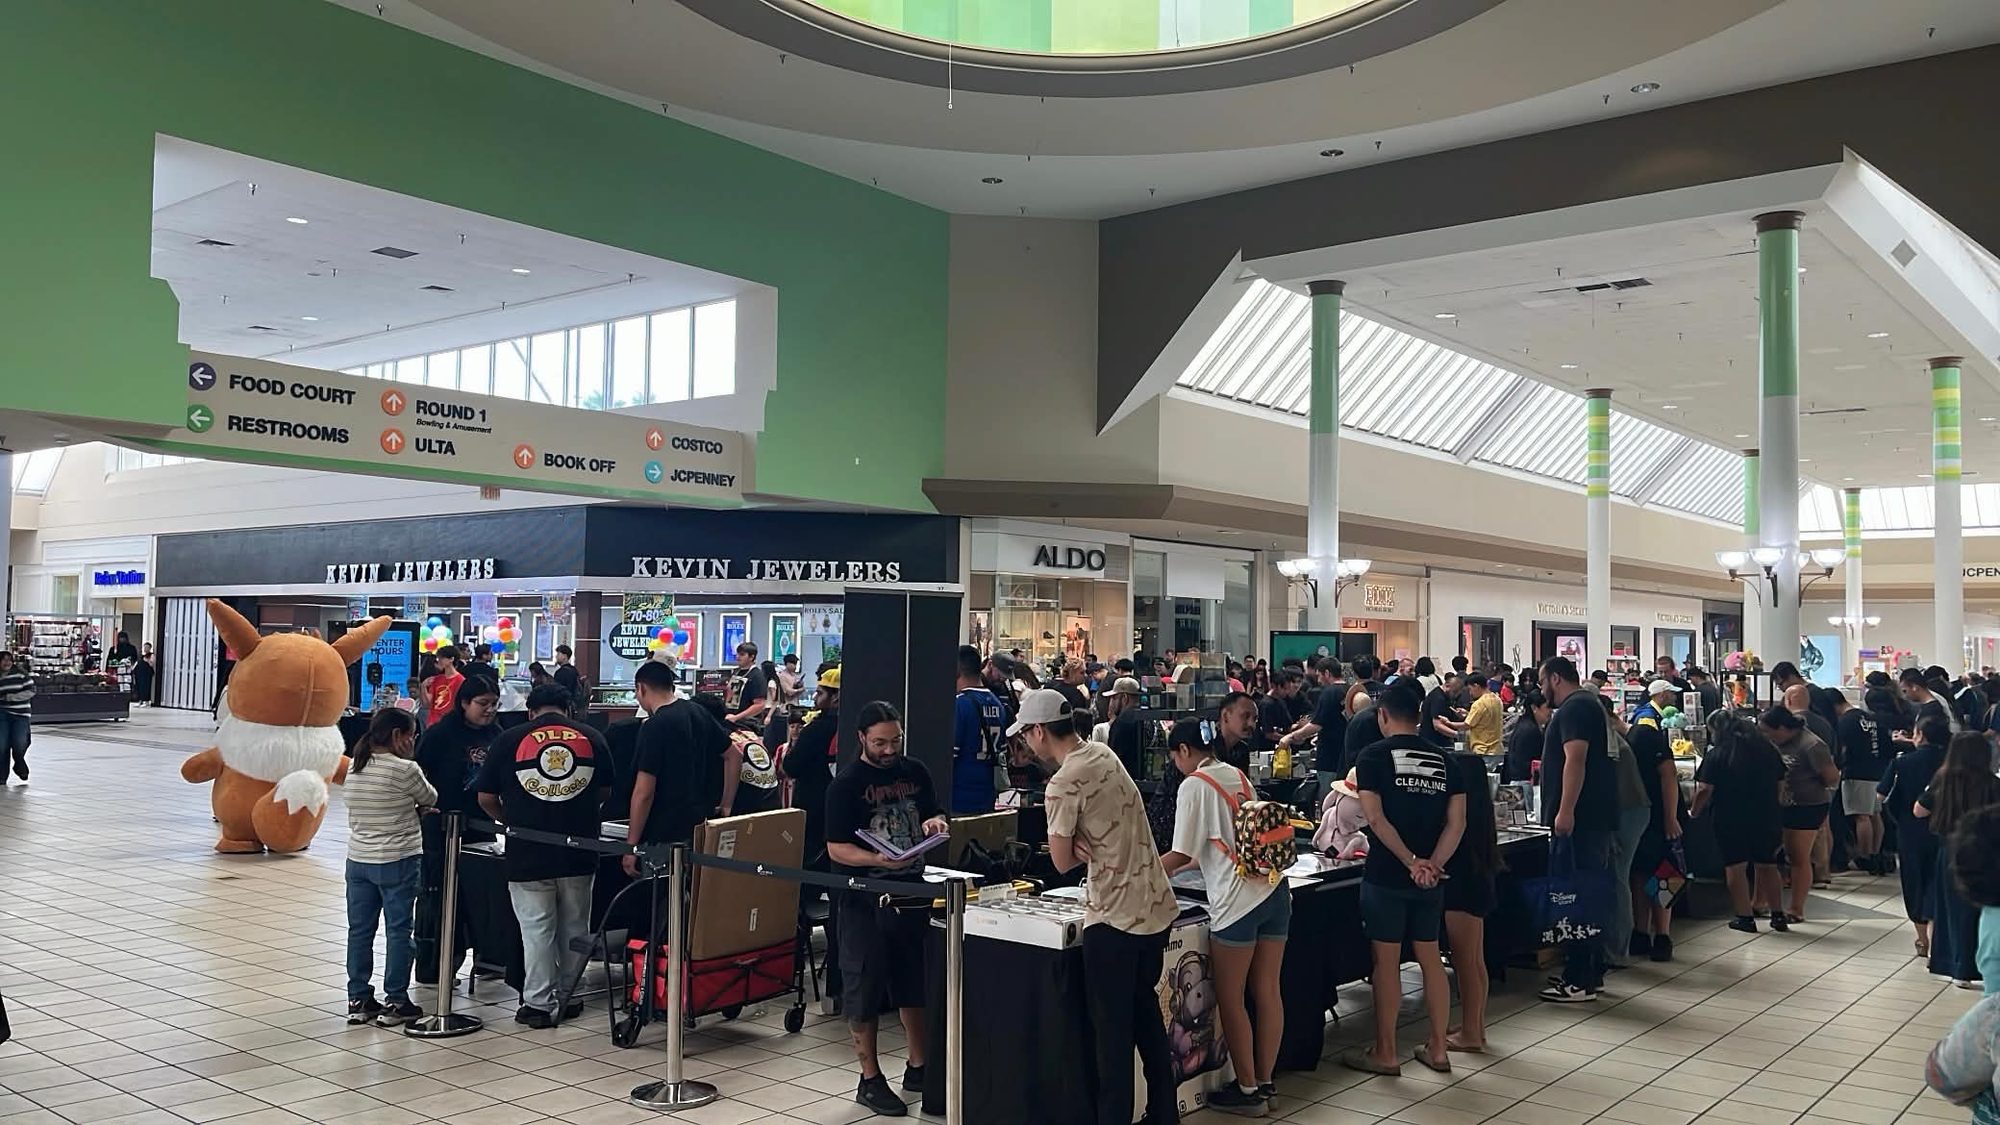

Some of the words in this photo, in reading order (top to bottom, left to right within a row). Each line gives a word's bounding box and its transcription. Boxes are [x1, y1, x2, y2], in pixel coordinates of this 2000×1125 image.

[229, 374, 285, 396] FOOD
[290, 383, 356, 405] COURT
[415, 399, 475, 421] ROUND
[479, 409, 486, 422] 1
[228, 415, 349, 443] RESTROOMS
[416, 418, 443, 429] Bowling
[445, 421, 451, 429] &
[452, 422, 492, 434] Amusement
[415, 437, 456, 456] ULTA
[671, 436, 723, 454] COSTCO
[544, 453, 586, 470] BOOK
[589, 458, 616, 474] OFF
[670, 469, 736, 487] JCPENNEY
[1033, 544, 1106, 571] ALDO
[326, 563, 380, 584] KEVIN
[392, 558, 494, 583] JEWELERS
[632, 556, 731, 578] KEVIN
[746, 559, 901, 582] JEWELERS
[621, 624, 647, 635] KEVIN
[376, 639, 405, 647] ENTER
[612, 636, 651, 648] JEWELE
[531, 730, 577, 743] DLP
[1395, 777, 1447, 792] CLEANLINE
[1549, 892, 1577, 903] Disney
